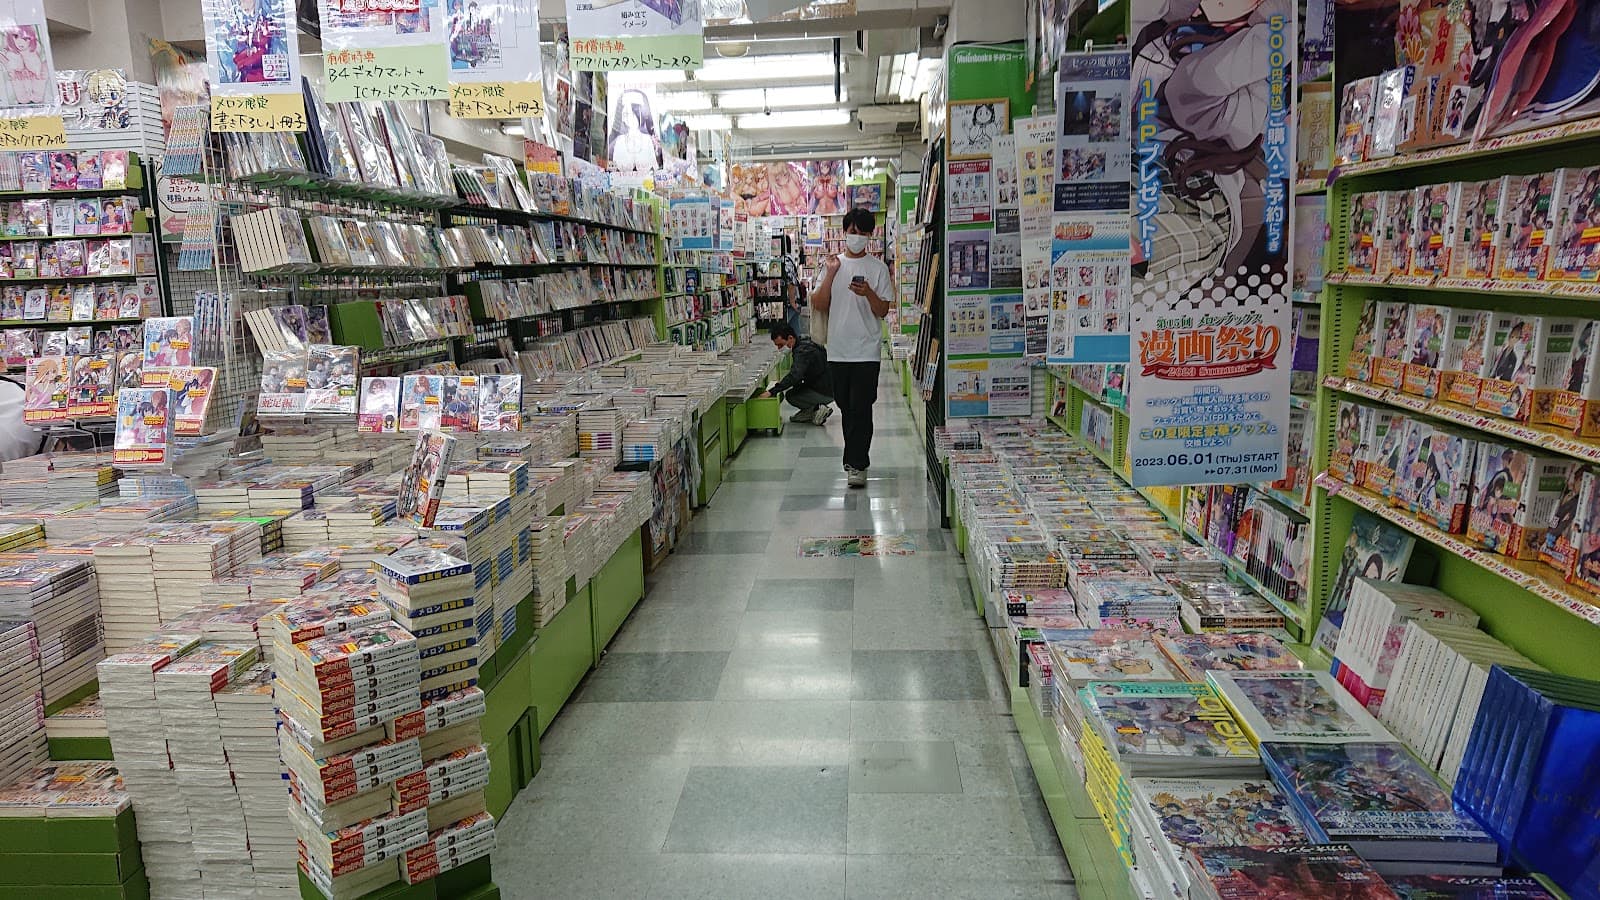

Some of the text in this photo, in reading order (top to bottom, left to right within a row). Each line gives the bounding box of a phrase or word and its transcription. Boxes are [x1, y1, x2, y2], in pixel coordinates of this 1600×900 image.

[453, 84, 505, 98] メロン限定
[216, 96, 268, 110] メロン限定
[214, 111, 305, 129] 書き下ろし小冊子
[1138, 324, 1281, 365] 漫画祭り
[1135, 452, 1280, 467] 2023.06.01 (Thu) START
[1216, 464, 1278, 475] 07.31 (Mon)
